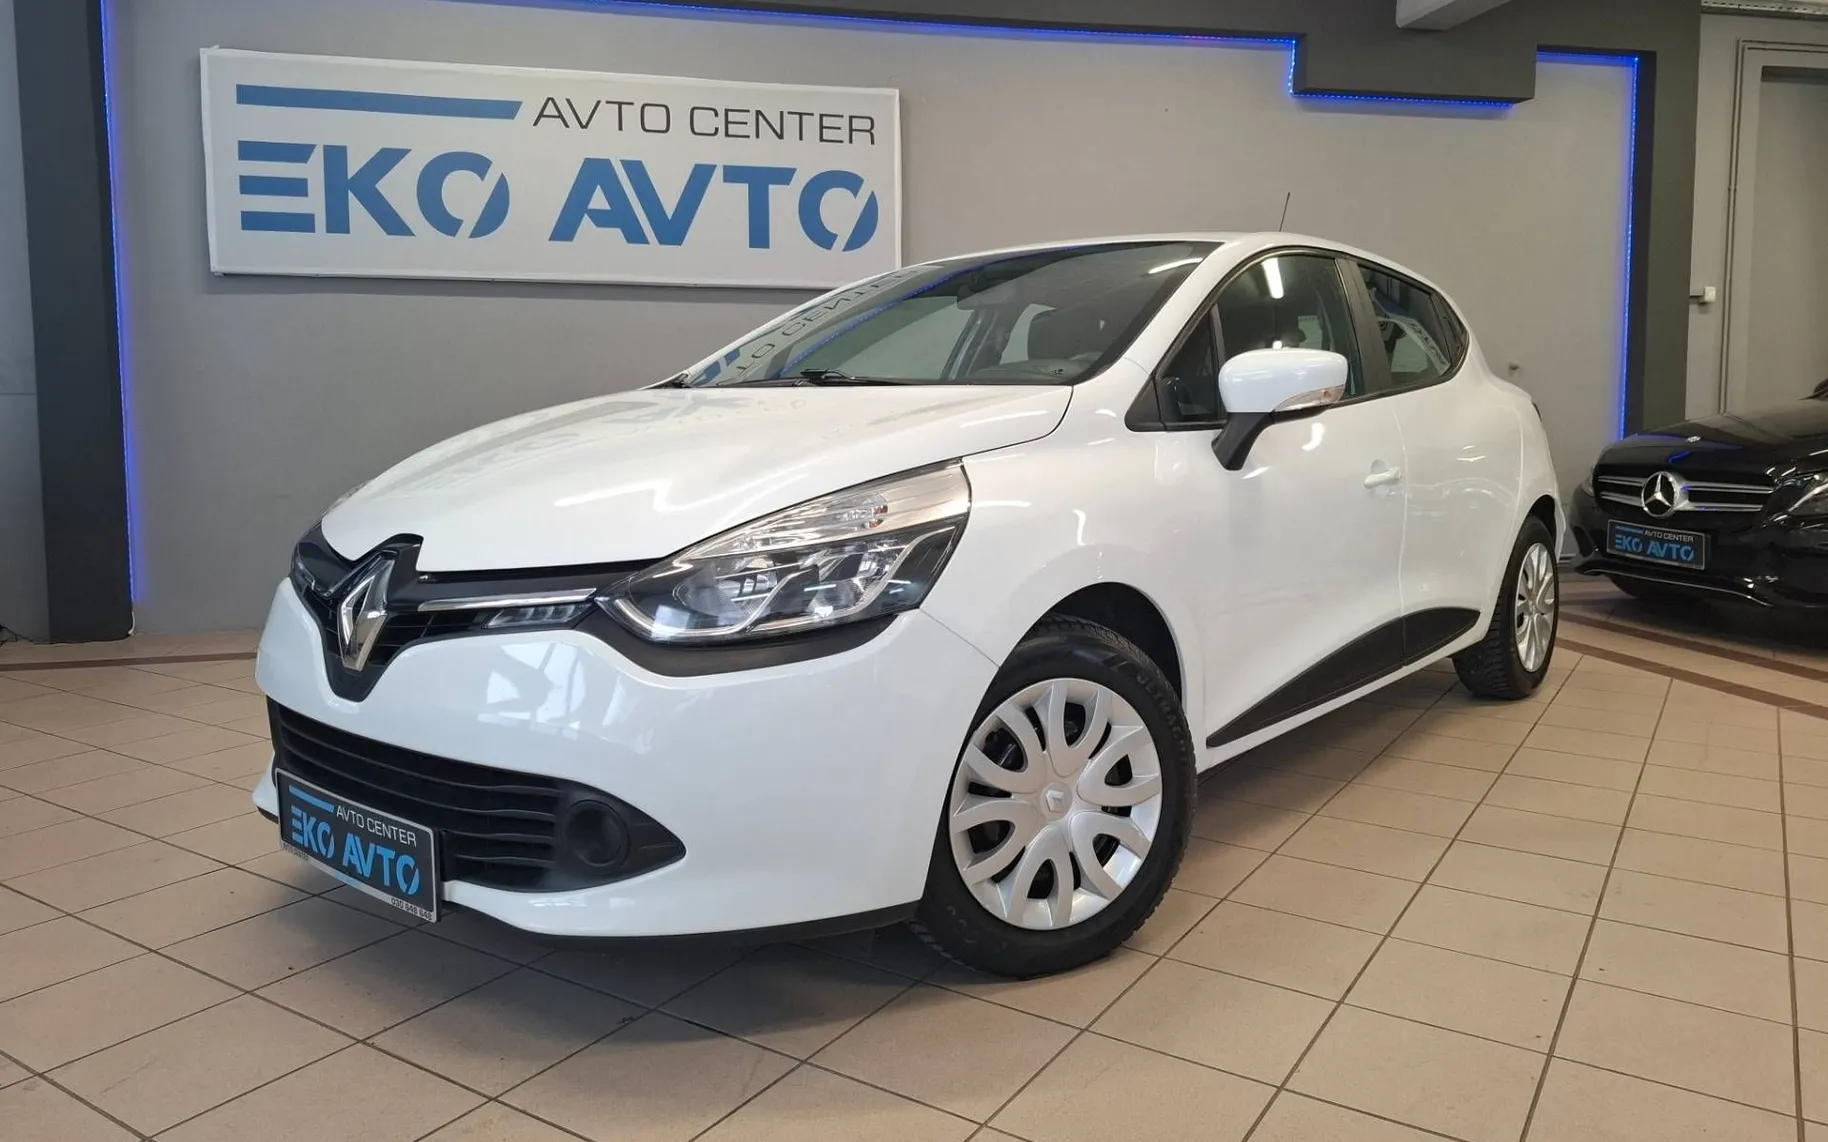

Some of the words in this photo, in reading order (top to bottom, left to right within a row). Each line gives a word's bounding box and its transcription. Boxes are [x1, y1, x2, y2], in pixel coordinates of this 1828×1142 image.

[532, 96, 672, 135] AVTO
[689, 106, 876, 145] CENTER
[237, 139, 510, 239] EKO
[547, 157, 879, 253] AVTO
[1615, 534, 1643, 553] EKO
[1647, 540, 1695, 562] AVTO
[1644, 530, 1663, 539] AVTO
[1663, 532, 1694, 543] CENTER
[291, 804, 335, 859] EKO
[342, 832, 420, 895] AVTO
[336, 805, 365, 829] AVTO
[367, 818, 417, 848] CENTER
